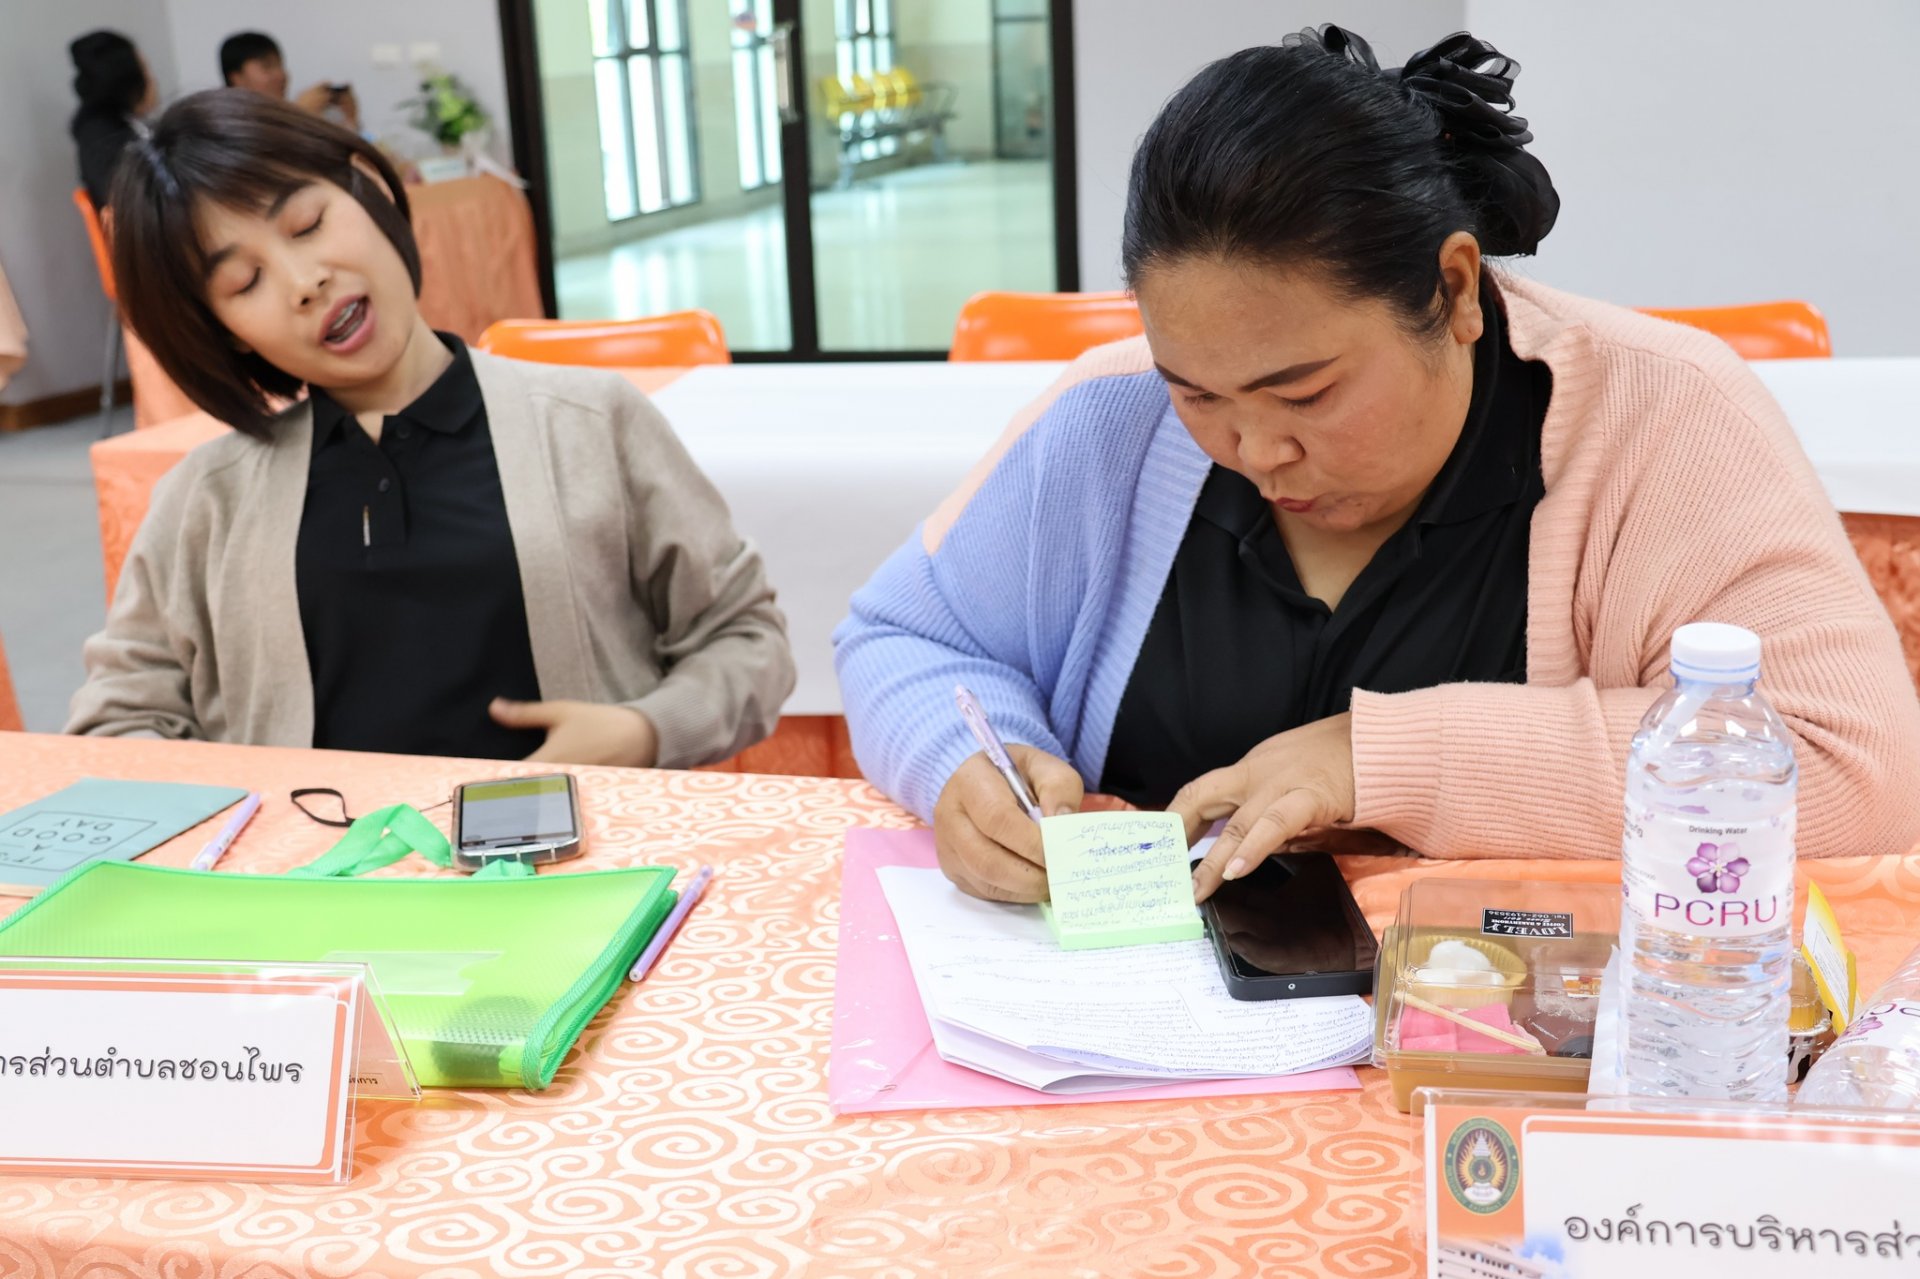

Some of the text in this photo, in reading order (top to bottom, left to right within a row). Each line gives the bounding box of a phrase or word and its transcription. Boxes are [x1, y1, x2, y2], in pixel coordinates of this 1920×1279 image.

[53, 818, 114, 832] DAY
[1688, 825, 1748, 836] Drinking Water
[12, 827, 112, 845] GOOD
[1654, 893, 1777, 927] PCRU
[1485, 923, 1570, 936] LOVELY
